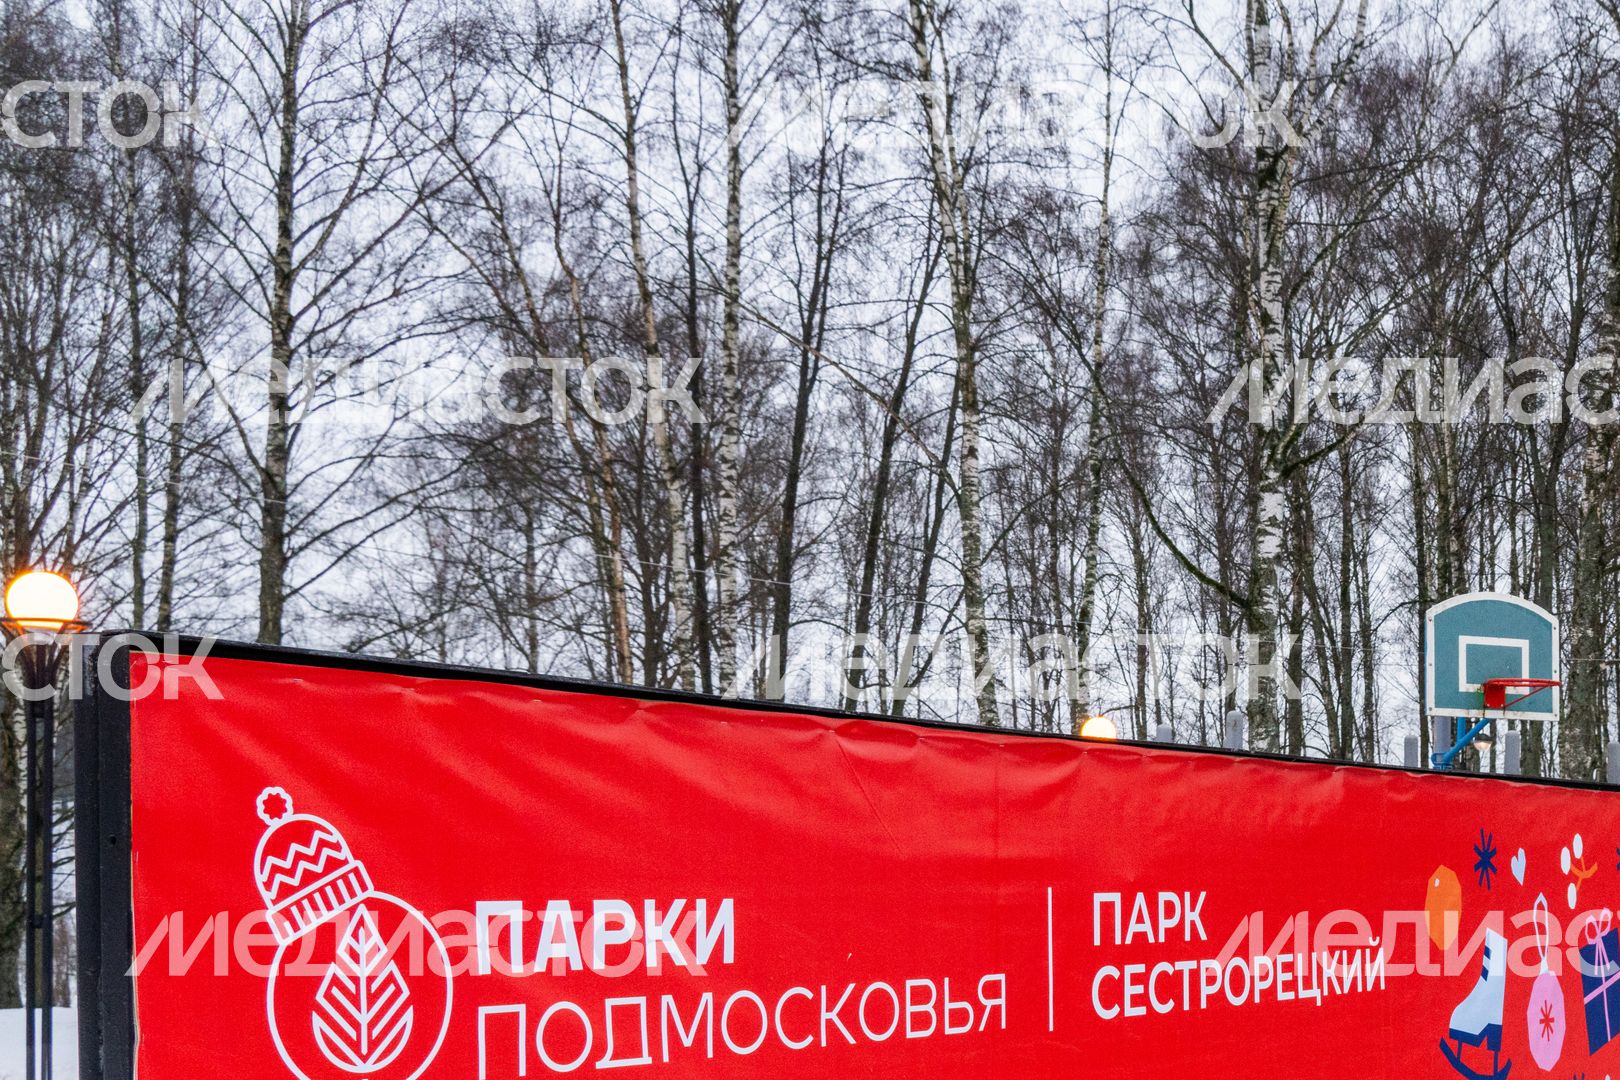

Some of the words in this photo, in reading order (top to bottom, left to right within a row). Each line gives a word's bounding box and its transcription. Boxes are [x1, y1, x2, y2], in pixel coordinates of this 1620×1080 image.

[476, 898, 735, 975] ПАРКИ
[1093, 891, 1207, 946] ПАРК
[1092, 936, 1386, 1020] СЕСТРОРЕЦКИЙ
[478, 973, 1007, 1080] ПОДМОСКОВЬЯ
